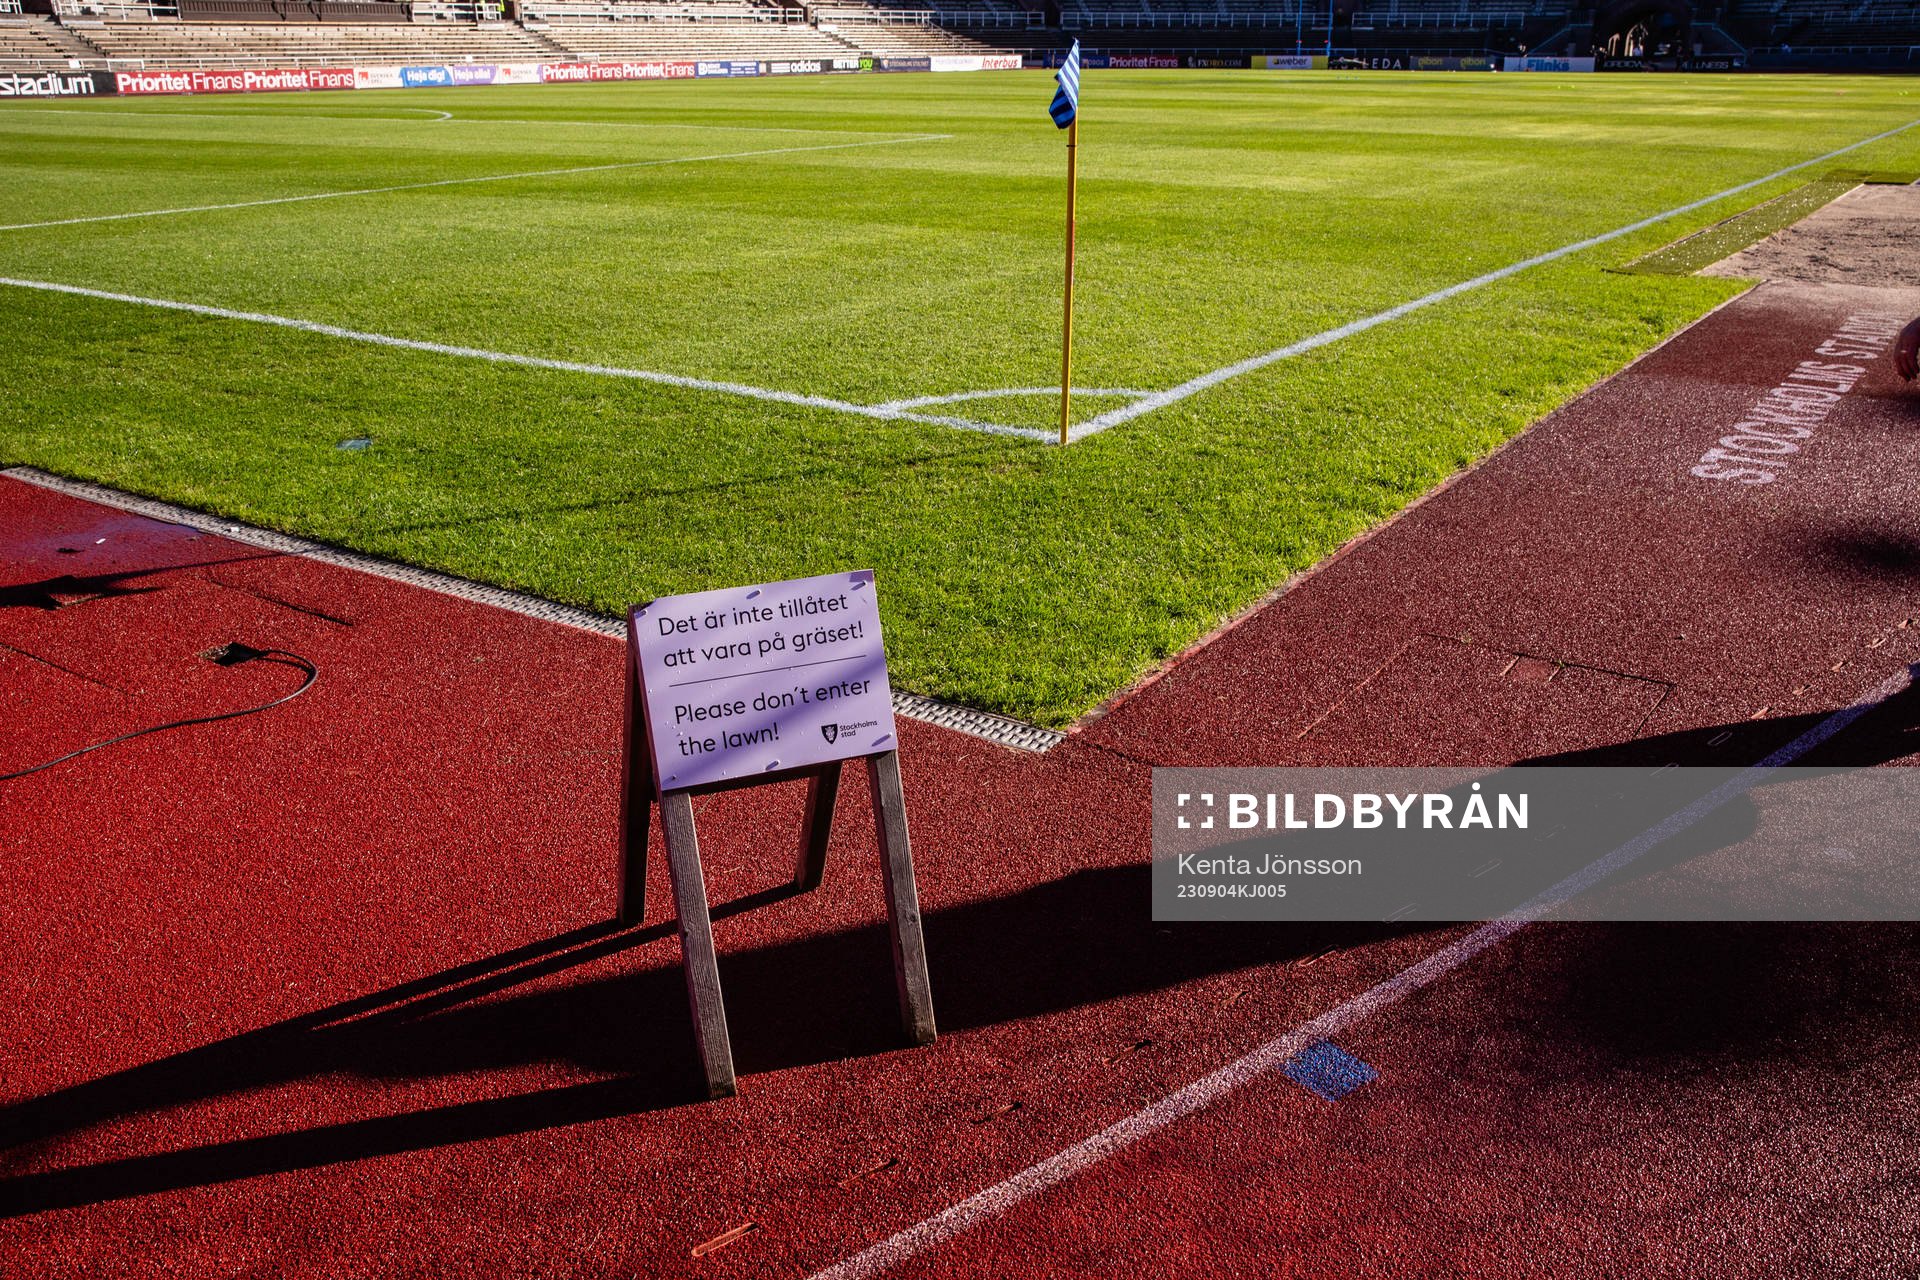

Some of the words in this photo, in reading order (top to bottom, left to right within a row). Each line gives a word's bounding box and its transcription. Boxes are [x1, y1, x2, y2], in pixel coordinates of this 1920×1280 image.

[791, 59, 821, 73] adidas
[860, 58, 873, 69] YOU
[982, 57, 1019, 69] Interbus
[1109, 56, 1148, 68] Prioritet
[1149, 56, 1179, 68] Finans
[1279, 56, 1308, 66] weber
[543, 65, 590, 80] Prioritet
[590, 64, 622, 78] Finans
[623, 63, 665, 78] Prioritet
[665, 62, 695, 76] Finans
[0, 73, 95, 95] stadium
[117, 73, 192, 91] Prioritet
[193, 72, 243, 89] Finans
[244, 71, 308, 88] Prioritet
[310, 70, 353, 86] Finans
[1690, 361, 1866, 484] STOCKHOLMS
[658, 615, 698, 636] Det
[704, 611, 726, 629] är
[732, 606, 773, 626] inte
[778, 594, 848, 618] tillåtet
[663, 647, 697, 667] att
[701, 639, 751, 661] vara
[758, 632, 786, 658] på
[792, 620, 864, 652] gräset!
[674, 698, 746, 724] Please
[815, 679, 871, 701] enter
[839, 720, 878, 731] Stockholms
[678, 737, 716, 756] the
[722, 722, 780, 750] lawn!
[840, 730, 856, 738] stad
